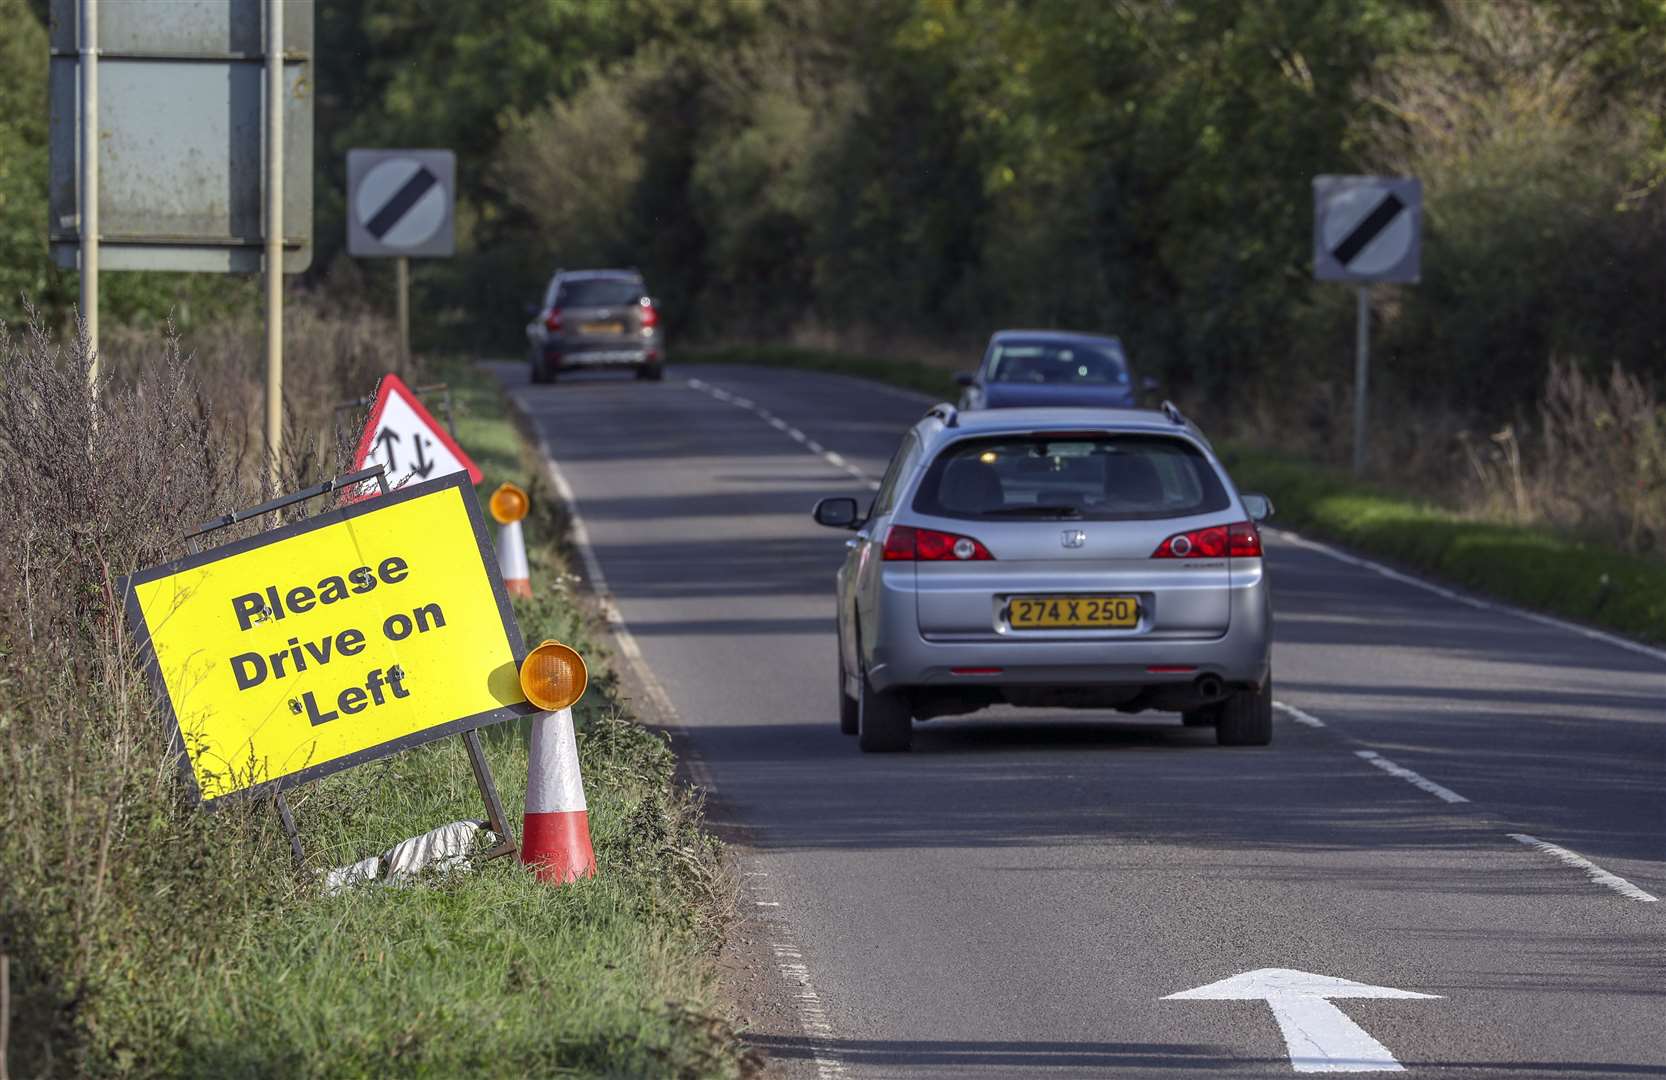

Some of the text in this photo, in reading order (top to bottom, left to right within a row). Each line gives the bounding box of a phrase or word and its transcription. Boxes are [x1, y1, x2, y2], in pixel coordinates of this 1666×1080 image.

[231, 556, 408, 630] Please
[1019, 602, 1128, 621] 274 X 250
[230, 603, 446, 690] Drive on
[302, 664, 409, 726] Left
